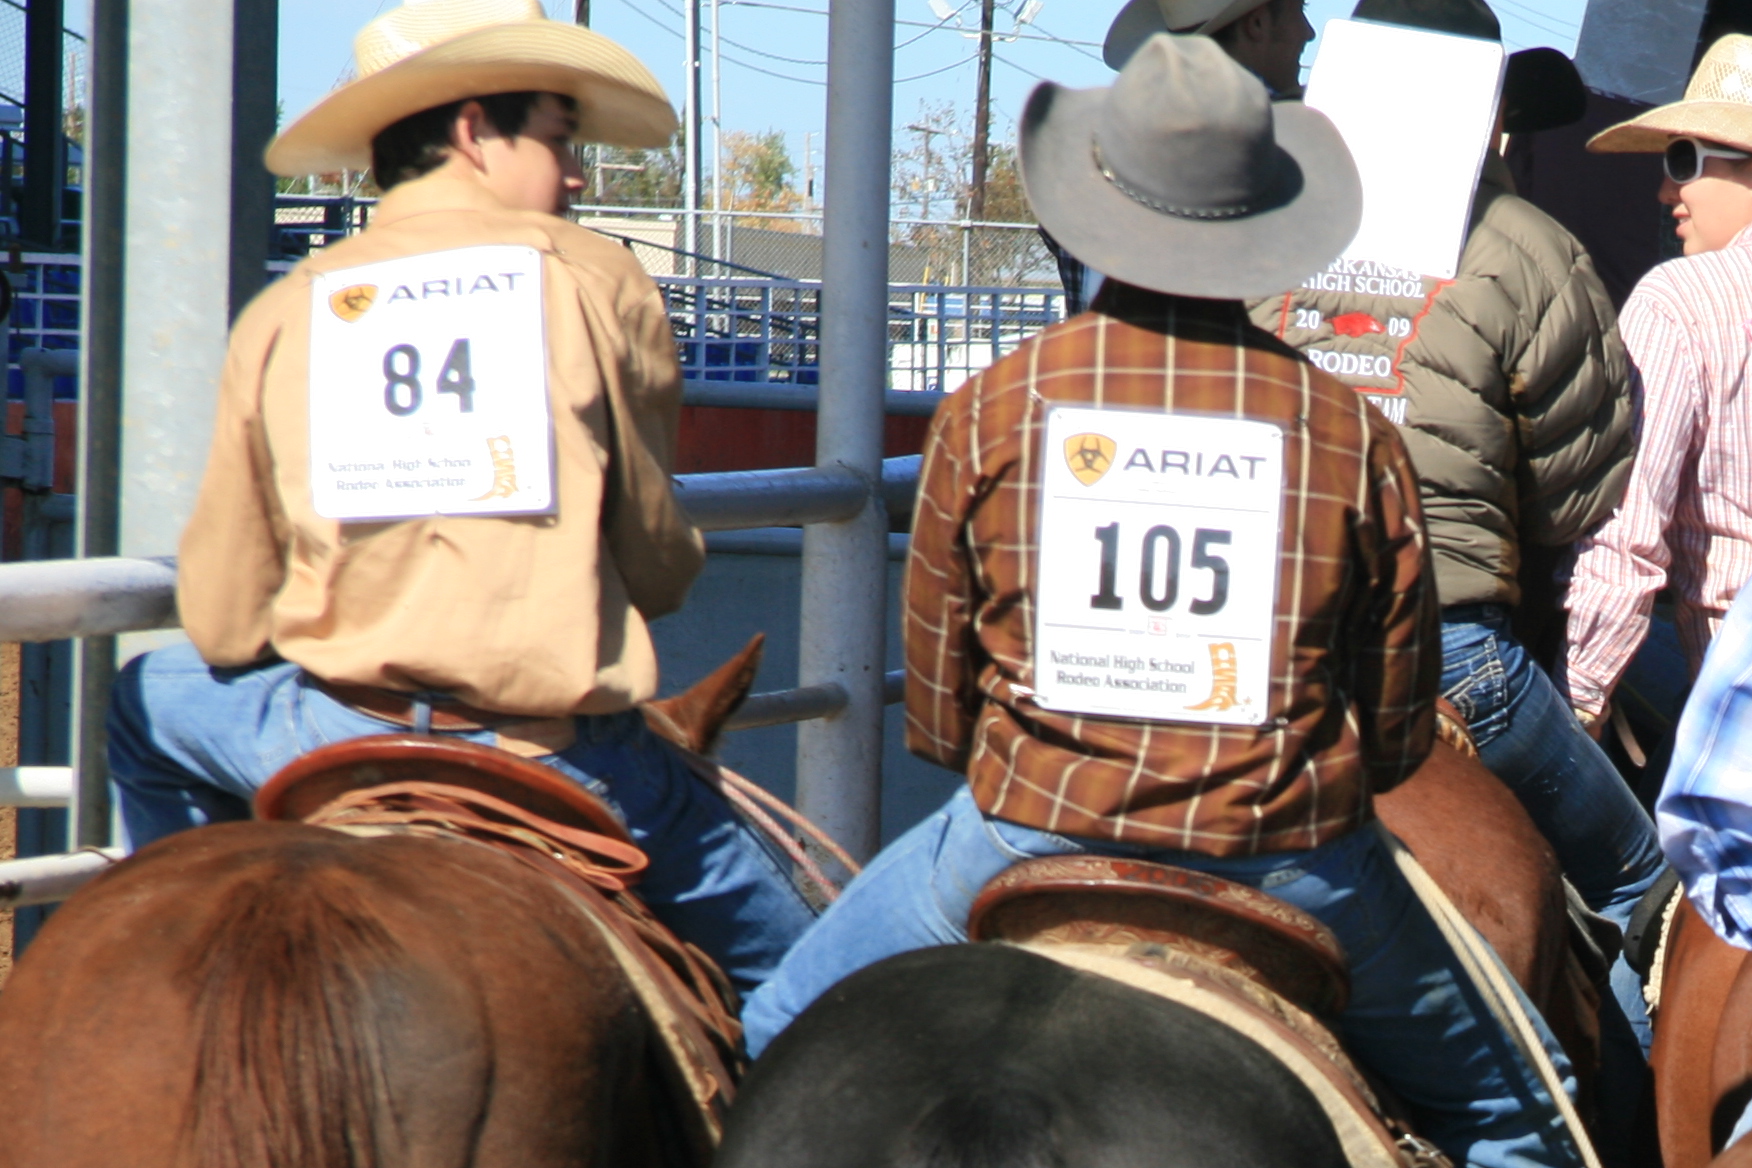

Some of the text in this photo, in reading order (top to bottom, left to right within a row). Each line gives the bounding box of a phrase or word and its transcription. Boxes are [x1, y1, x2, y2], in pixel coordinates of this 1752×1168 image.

[1326, 257, 1421, 281] RKANSAS
[387, 272, 525, 304] ARIAT
[1354, 276, 1425, 299] SCHOOL
[1296, 308, 1320, 330] 20
[1388, 317, 1411, 337] 09
[1308, 348, 1391, 377] RODEO
[382, 337, 476, 417] 84
[1123, 448, 1267, 480] ARIAT
[1090, 521, 1233, 616] 105
[1050, 649, 1195, 674] National High School
[1056, 669, 1187, 693] Rodeo Association
